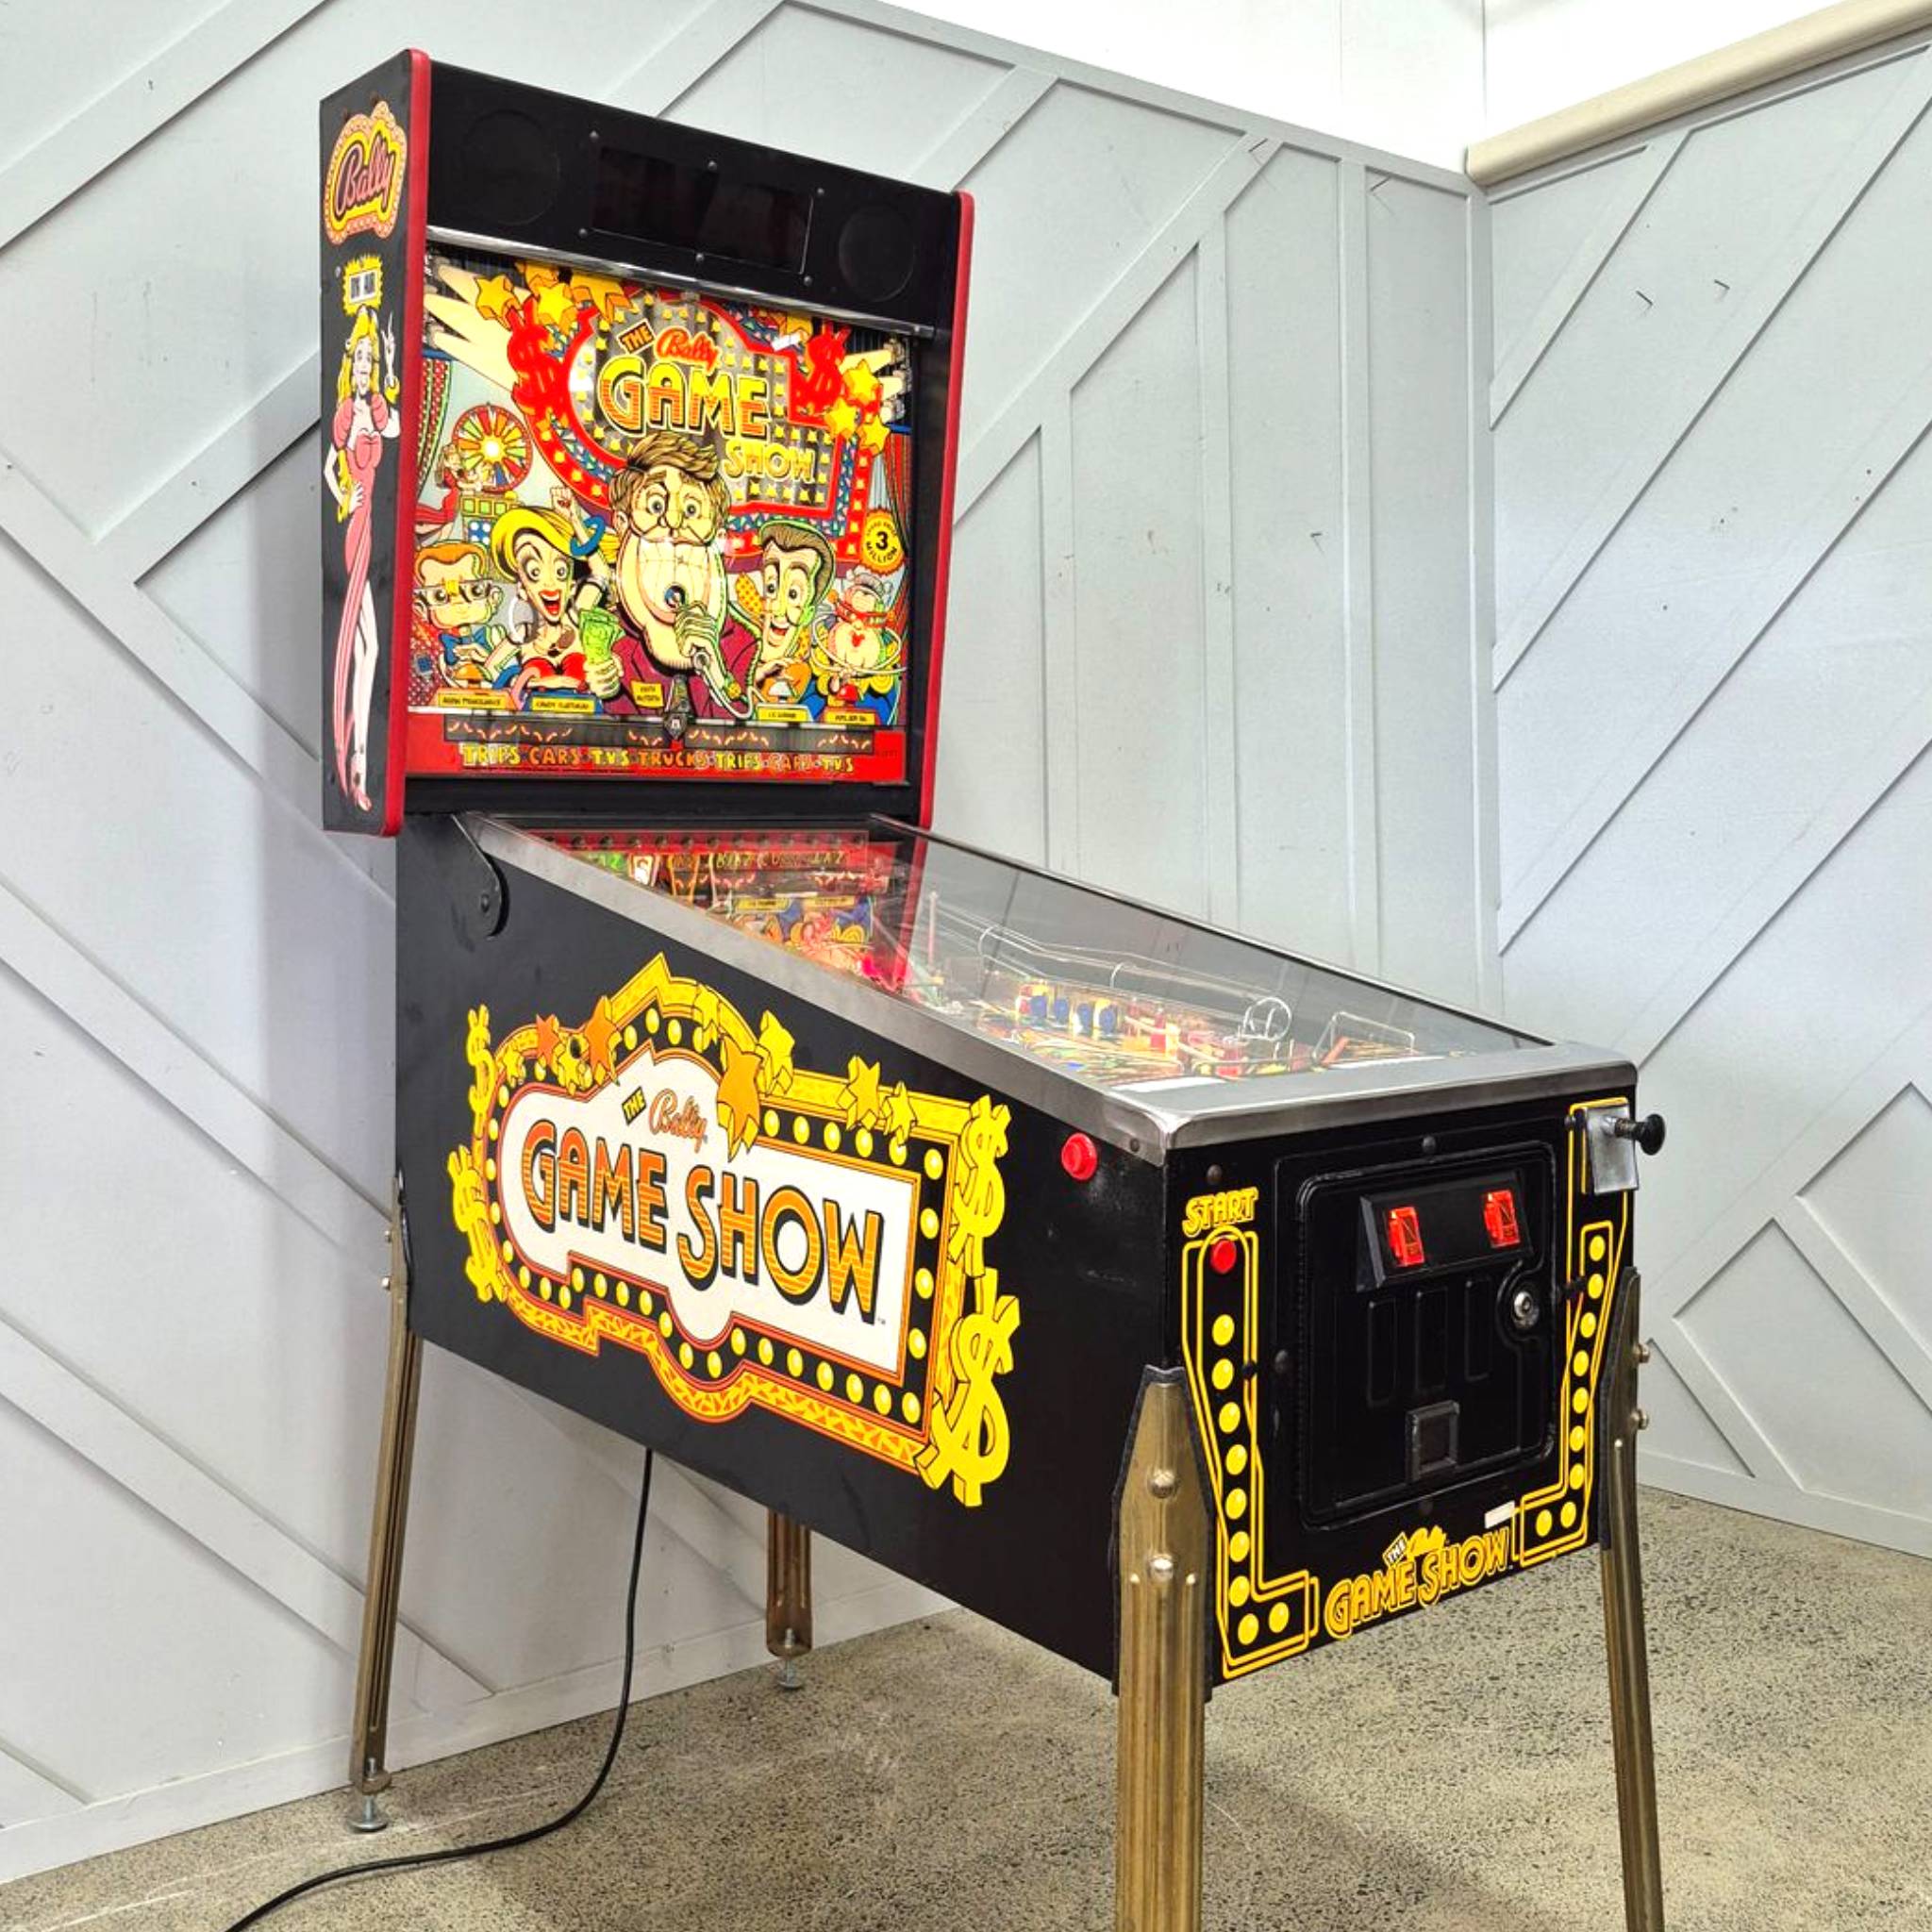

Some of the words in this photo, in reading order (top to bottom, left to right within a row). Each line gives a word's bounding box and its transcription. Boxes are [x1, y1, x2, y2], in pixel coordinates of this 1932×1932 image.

[336, 133, 395, 219] Bally
[622, 323, 654, 352] THE
[656, 327, 720, 374] Bally
[599, 358, 772, 439] GAME
[724, 440, 815, 483] SHOW
[875, 531, 889, 550] 3
[528, 747, 580, 766] CARS
[624, 1088, 646, 1123] THE
[648, 1088, 707, 1154] Bally
[521, 1119, 668, 1254] GAME
[676, 1163, 885, 1325] SHOW
[1182, 1187, 1258, 1238] START
[1324, 1558, 1416, 1640] GAME
[1417, 1525, 1510, 1607] SHOW
